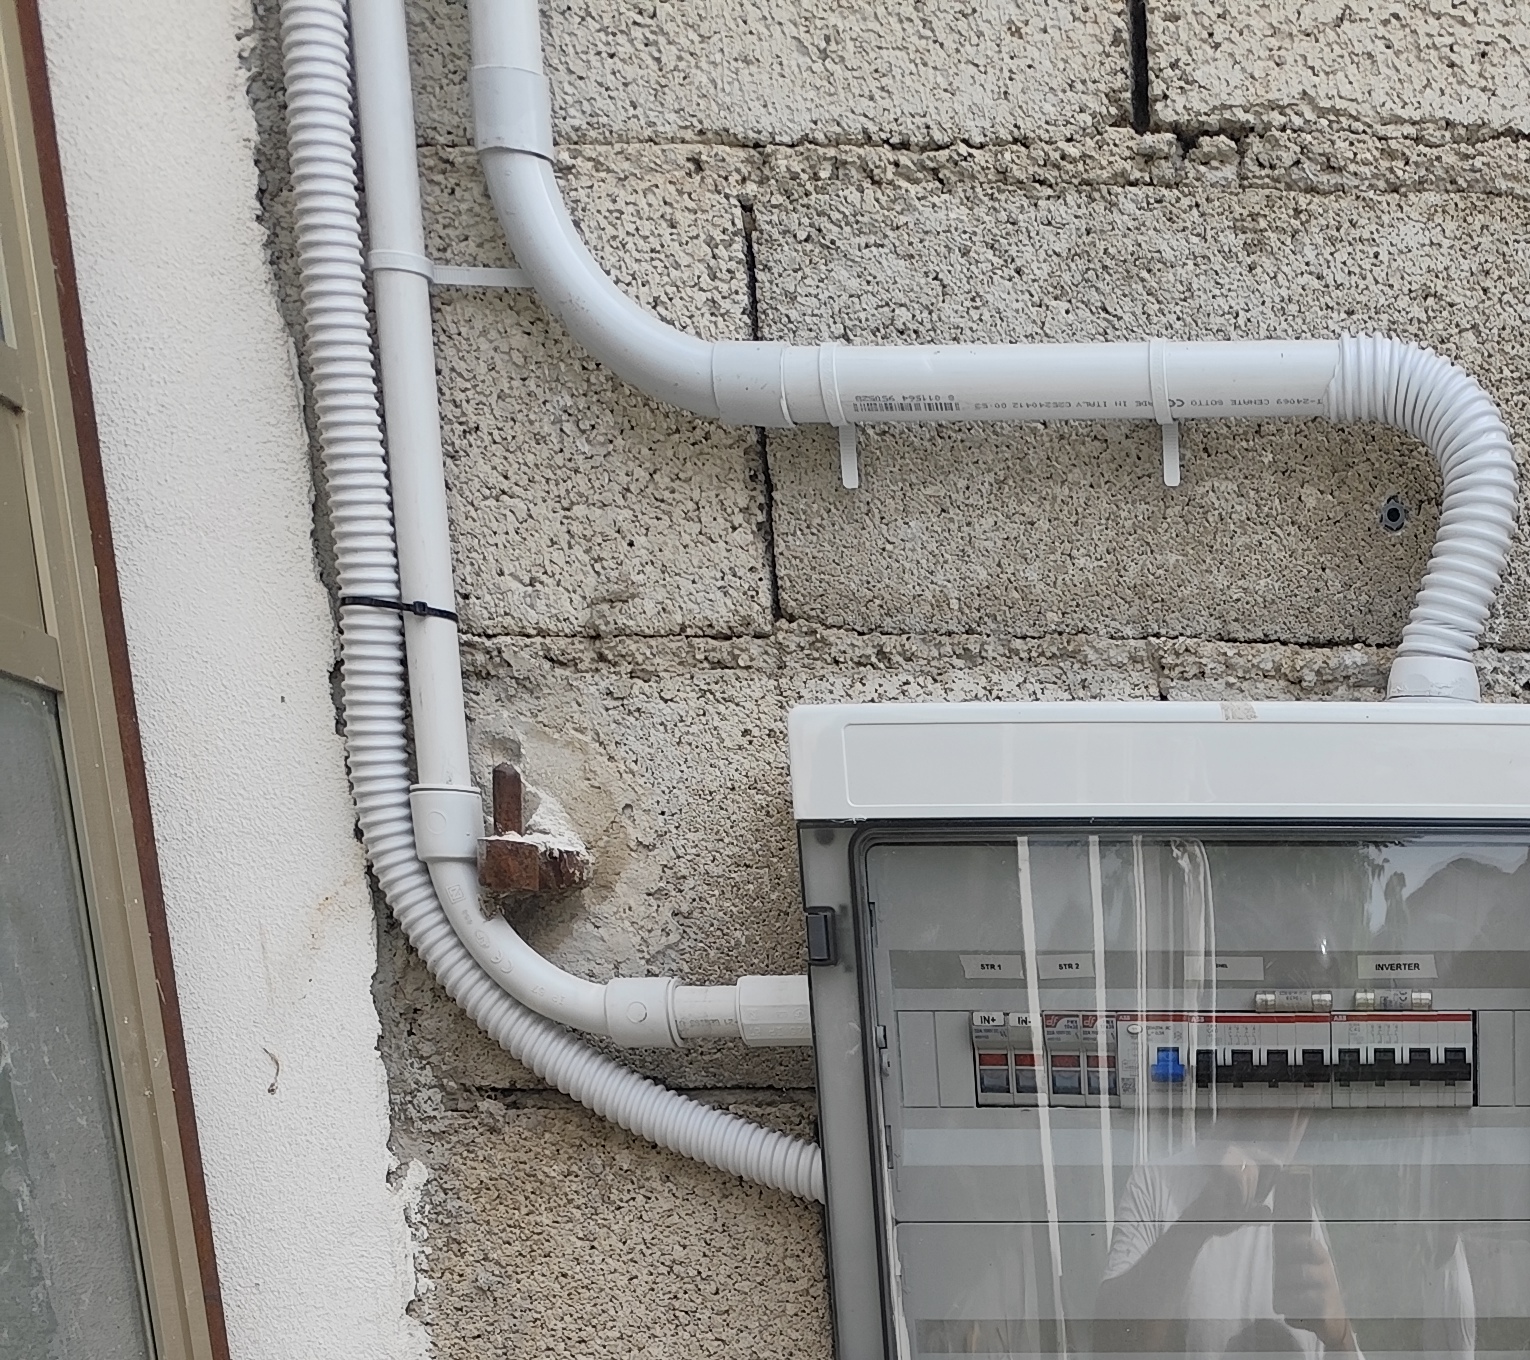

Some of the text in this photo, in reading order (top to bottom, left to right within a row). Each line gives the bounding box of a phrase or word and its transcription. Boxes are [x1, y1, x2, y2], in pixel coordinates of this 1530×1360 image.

[1076, 400, 1108, 408] ITALY
[1058, 963, 1074, 971] STR
[1375, 962, 1421, 971] INVERTER
[980, 1015, 996, 1025] IN+
